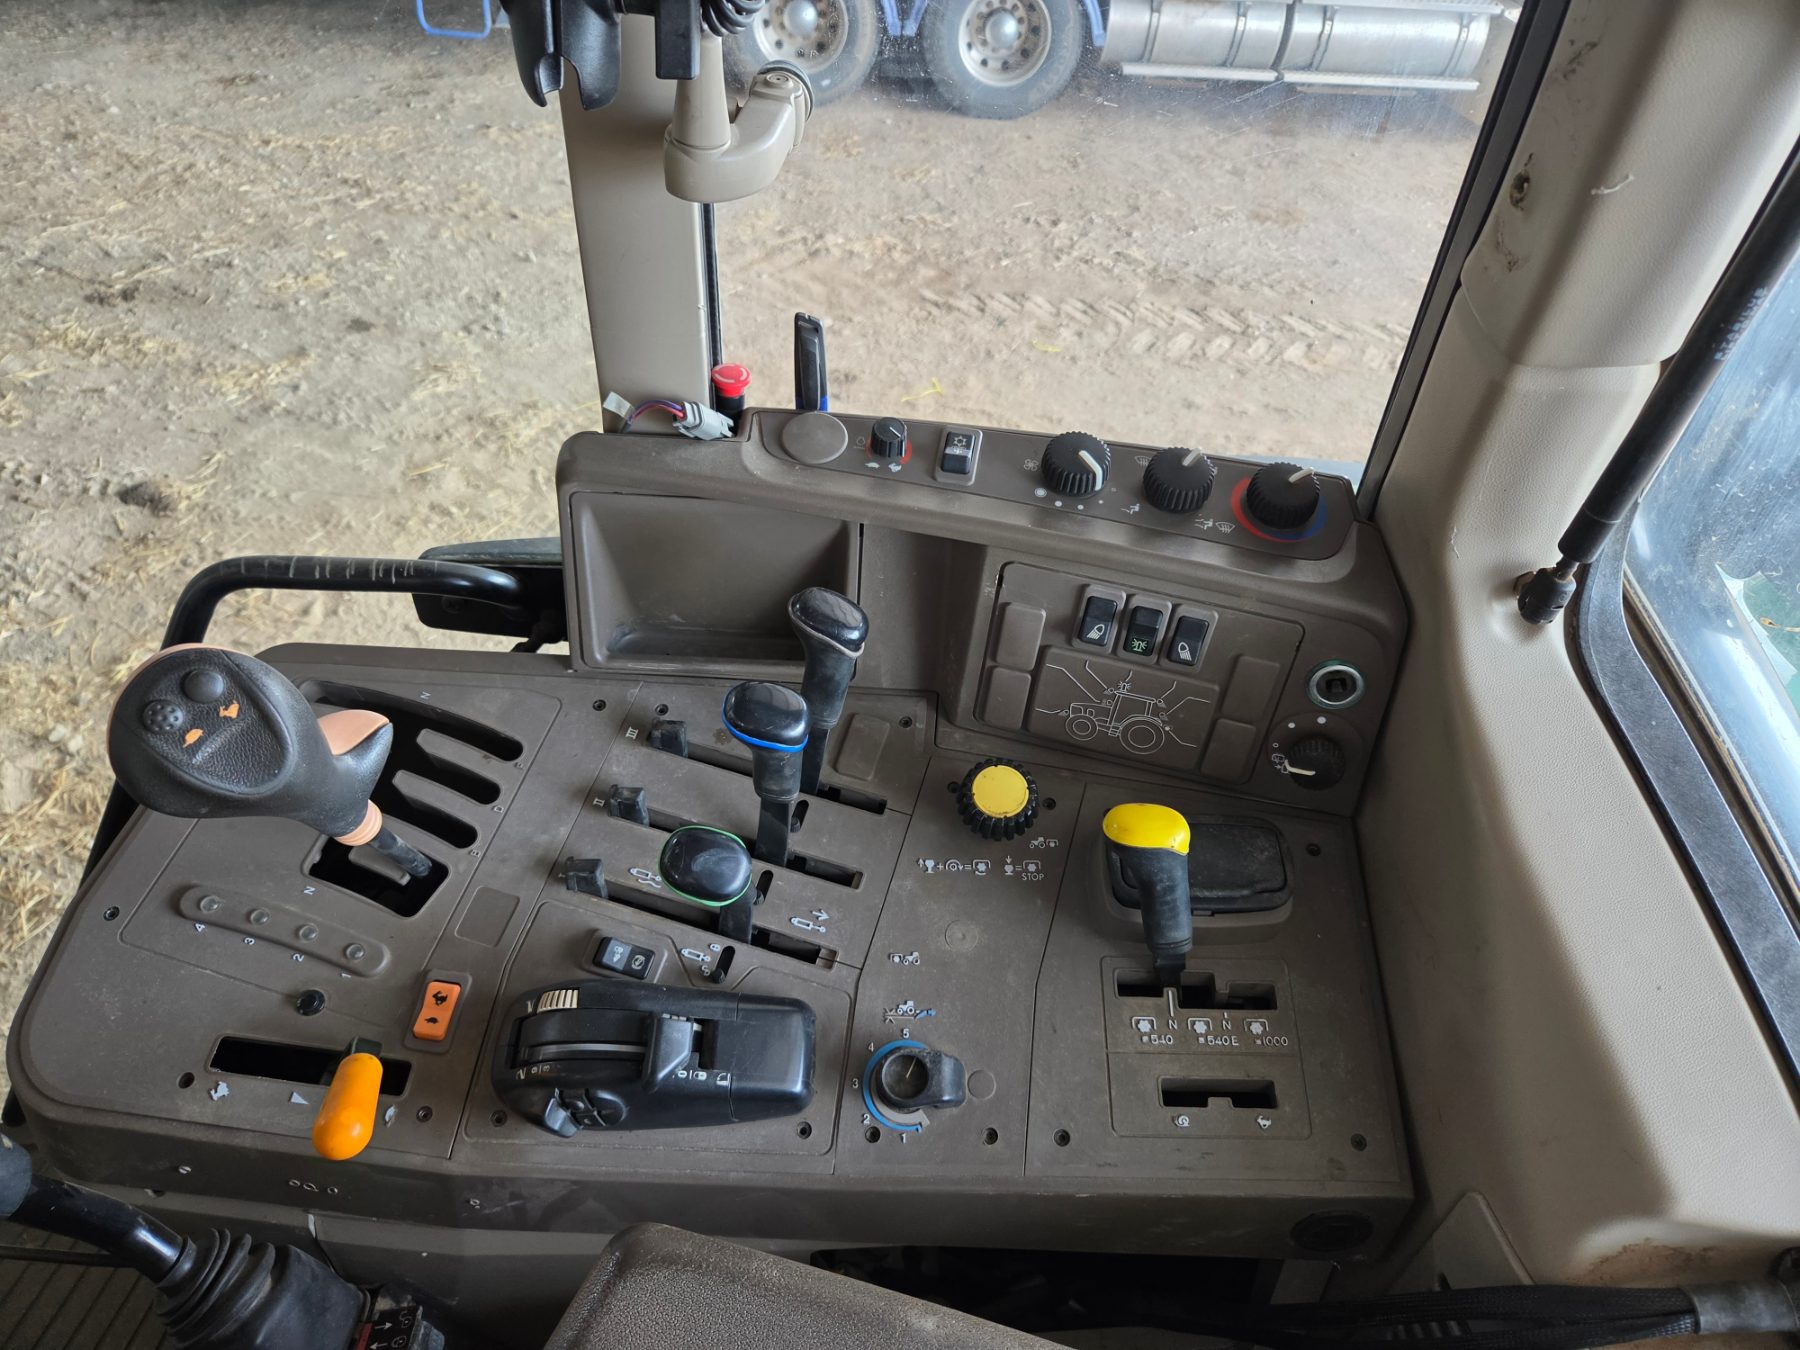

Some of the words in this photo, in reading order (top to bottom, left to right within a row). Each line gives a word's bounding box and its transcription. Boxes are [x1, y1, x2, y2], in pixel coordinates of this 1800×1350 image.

[1021, 872, 1045, 881] STOP
[194, 922, 207, 933] 4
[244, 937, 256, 946] 3
[292, 953, 305, 963] 2
[1168, 1019, 1178, 1030] N
[1222, 1019, 1232, 1031] N
[902, 1028, 910, 1039] 5
[1150, 1034, 1174, 1045] 540
[1262, 1035, 1289, 1047] 1000
[867, 1042, 875, 1052] 4
[851, 1078, 859, 1089] 3
[863, 1113, 871, 1124] 2
[901, 1133, 907, 1144] 1
